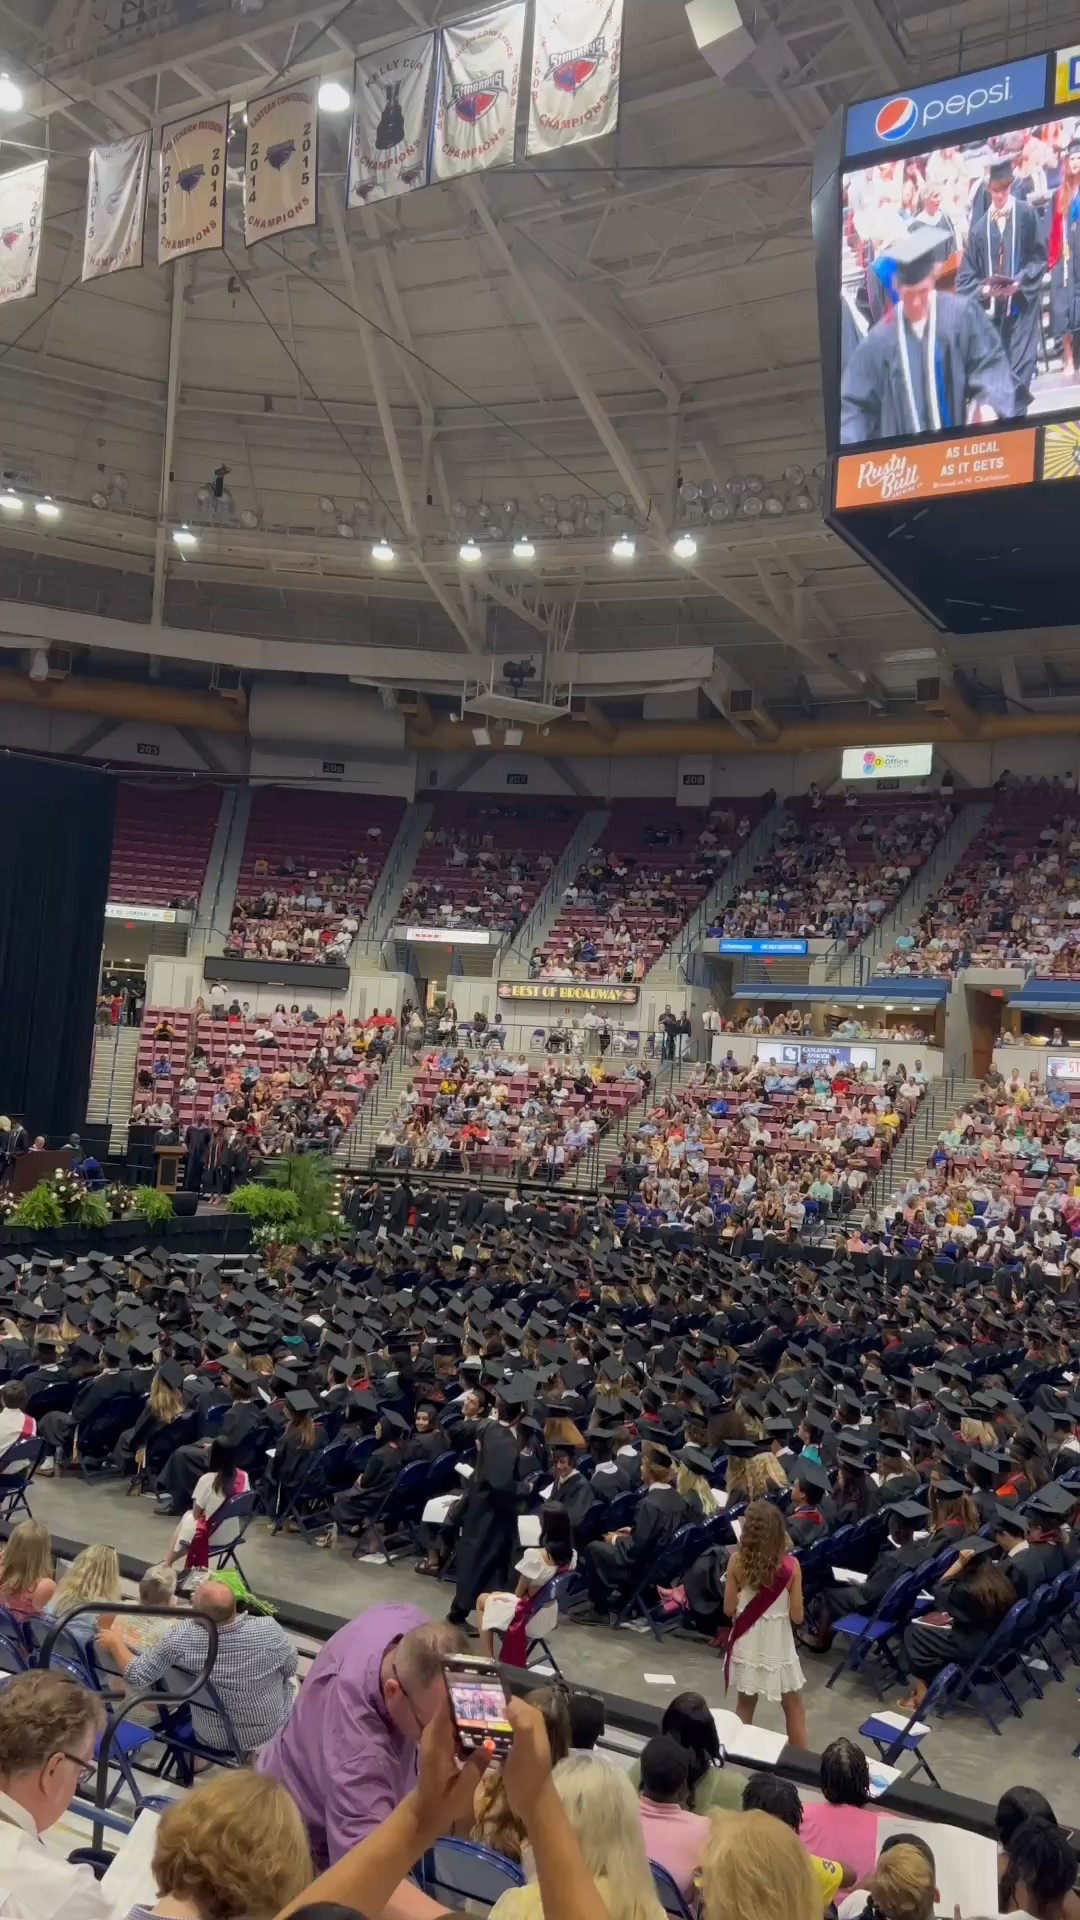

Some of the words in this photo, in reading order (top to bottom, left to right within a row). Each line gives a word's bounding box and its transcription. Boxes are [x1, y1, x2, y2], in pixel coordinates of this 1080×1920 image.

[365, 59, 399, 88] KELLY
[539, 94, 609, 131] CHAMPIONS
[922, 75, 1011, 127] pepsi
[301, 121, 312, 186] 2015
[360, 138, 421, 170] CHAMPIONS
[442, 128, 506, 160] CHAMPIONS
[209, 148, 221, 208] 2014
[248, 142, 260, 204] 2014
[160, 166, 171, 225] 2013
[27, 200, 38, 258] 2017
[248, 196, 311, 229] CHAMPIONS
[160, 219, 217, 250] CHAMPIONS
[946, 445, 961, 459] AS
[963, 440, 1000, 457] LOCAL
[857, 453, 906, 489] Rusty
[881, 464, 919, 499] Bull
[940, 463, 955, 477] AS
[958, 461, 970, 475] IT
[973, 457, 1004, 472] GETS
[884, 758, 909, 766] Office
[512, 985, 540, 997] BEST
[542, 986, 558, 998] OF
[560, 986, 624, 1001] BROADWAY
[802, 1046, 841, 1055] COLDWELL
